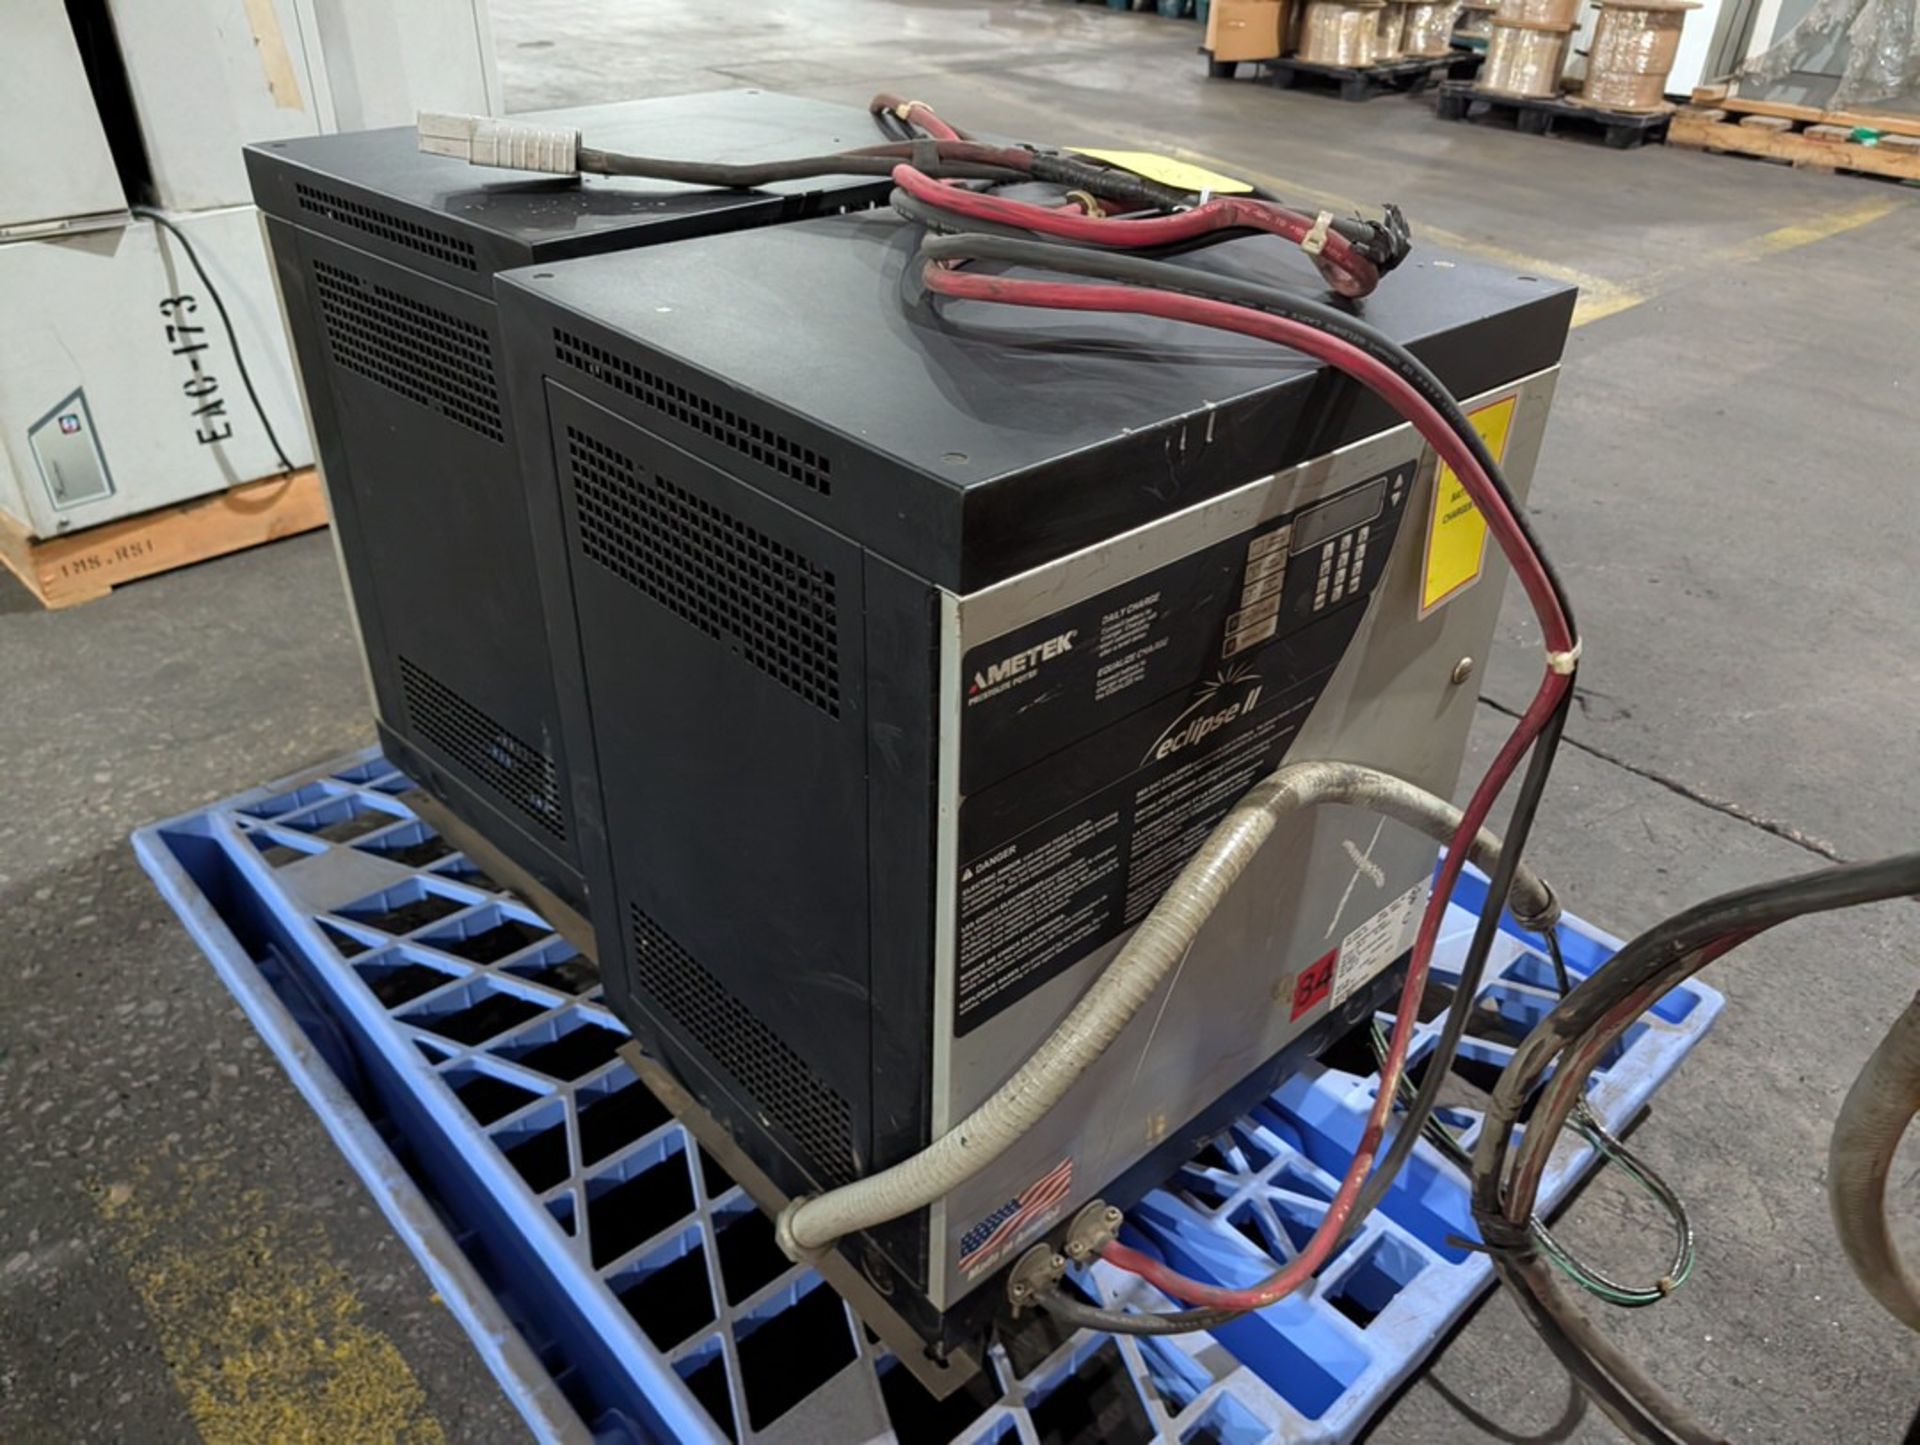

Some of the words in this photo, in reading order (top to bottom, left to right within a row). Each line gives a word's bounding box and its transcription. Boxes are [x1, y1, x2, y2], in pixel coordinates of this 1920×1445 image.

[1127, 591, 1161, 614] CHARGE
[968, 633, 1073, 694] AMETEK
[1156, 702, 1240, 760] eclipse
[975, 844, 1017, 874] DANGER
[1299, 961, 1334, 1007] 34
